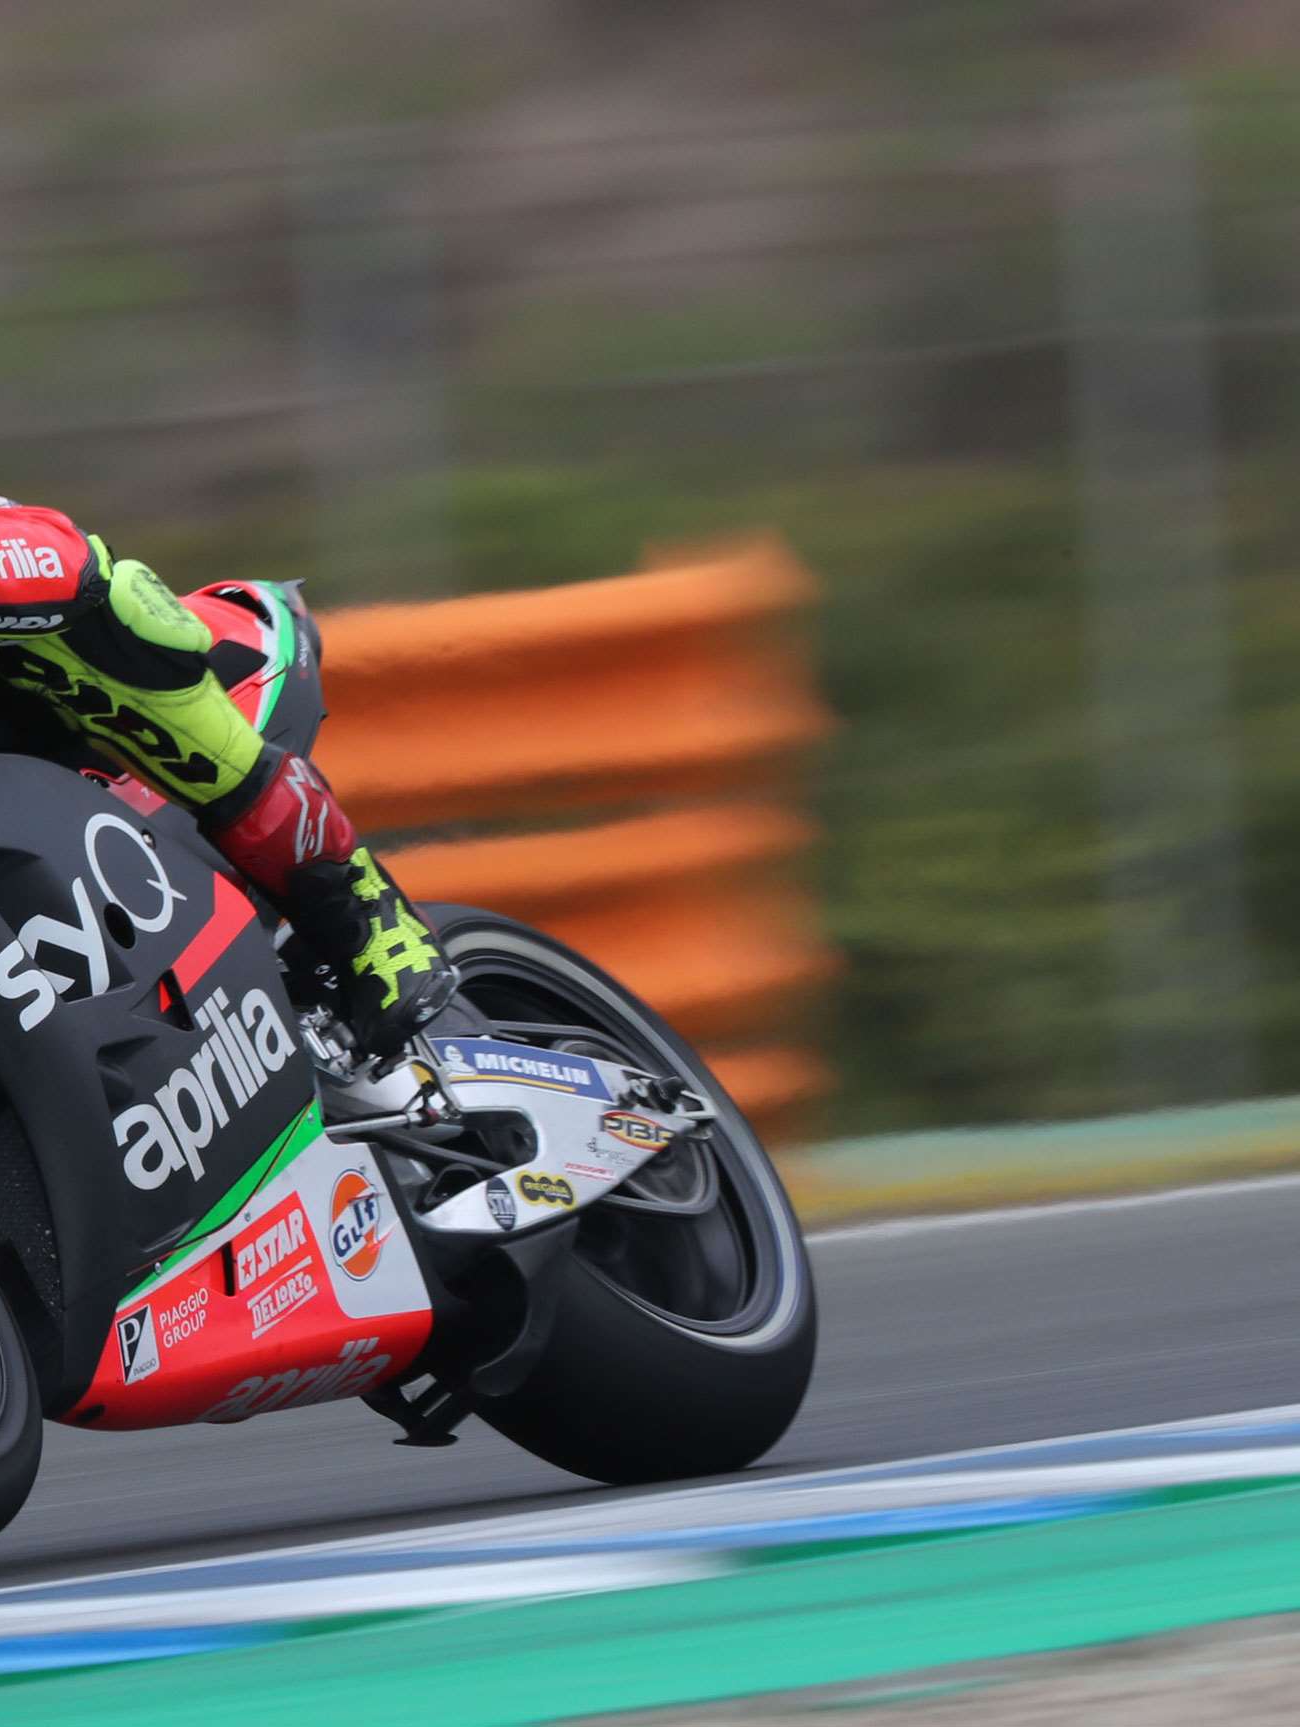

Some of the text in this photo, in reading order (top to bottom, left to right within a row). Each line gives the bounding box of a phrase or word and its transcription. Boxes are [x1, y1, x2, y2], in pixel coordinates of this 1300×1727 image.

[112, 986, 297, 1191] aprilia
[473, 1052, 592, 1086] MICHELIN
[159, 1287, 208, 1330] PIAGGIO
[162, 1309, 208, 1349] GROUP
